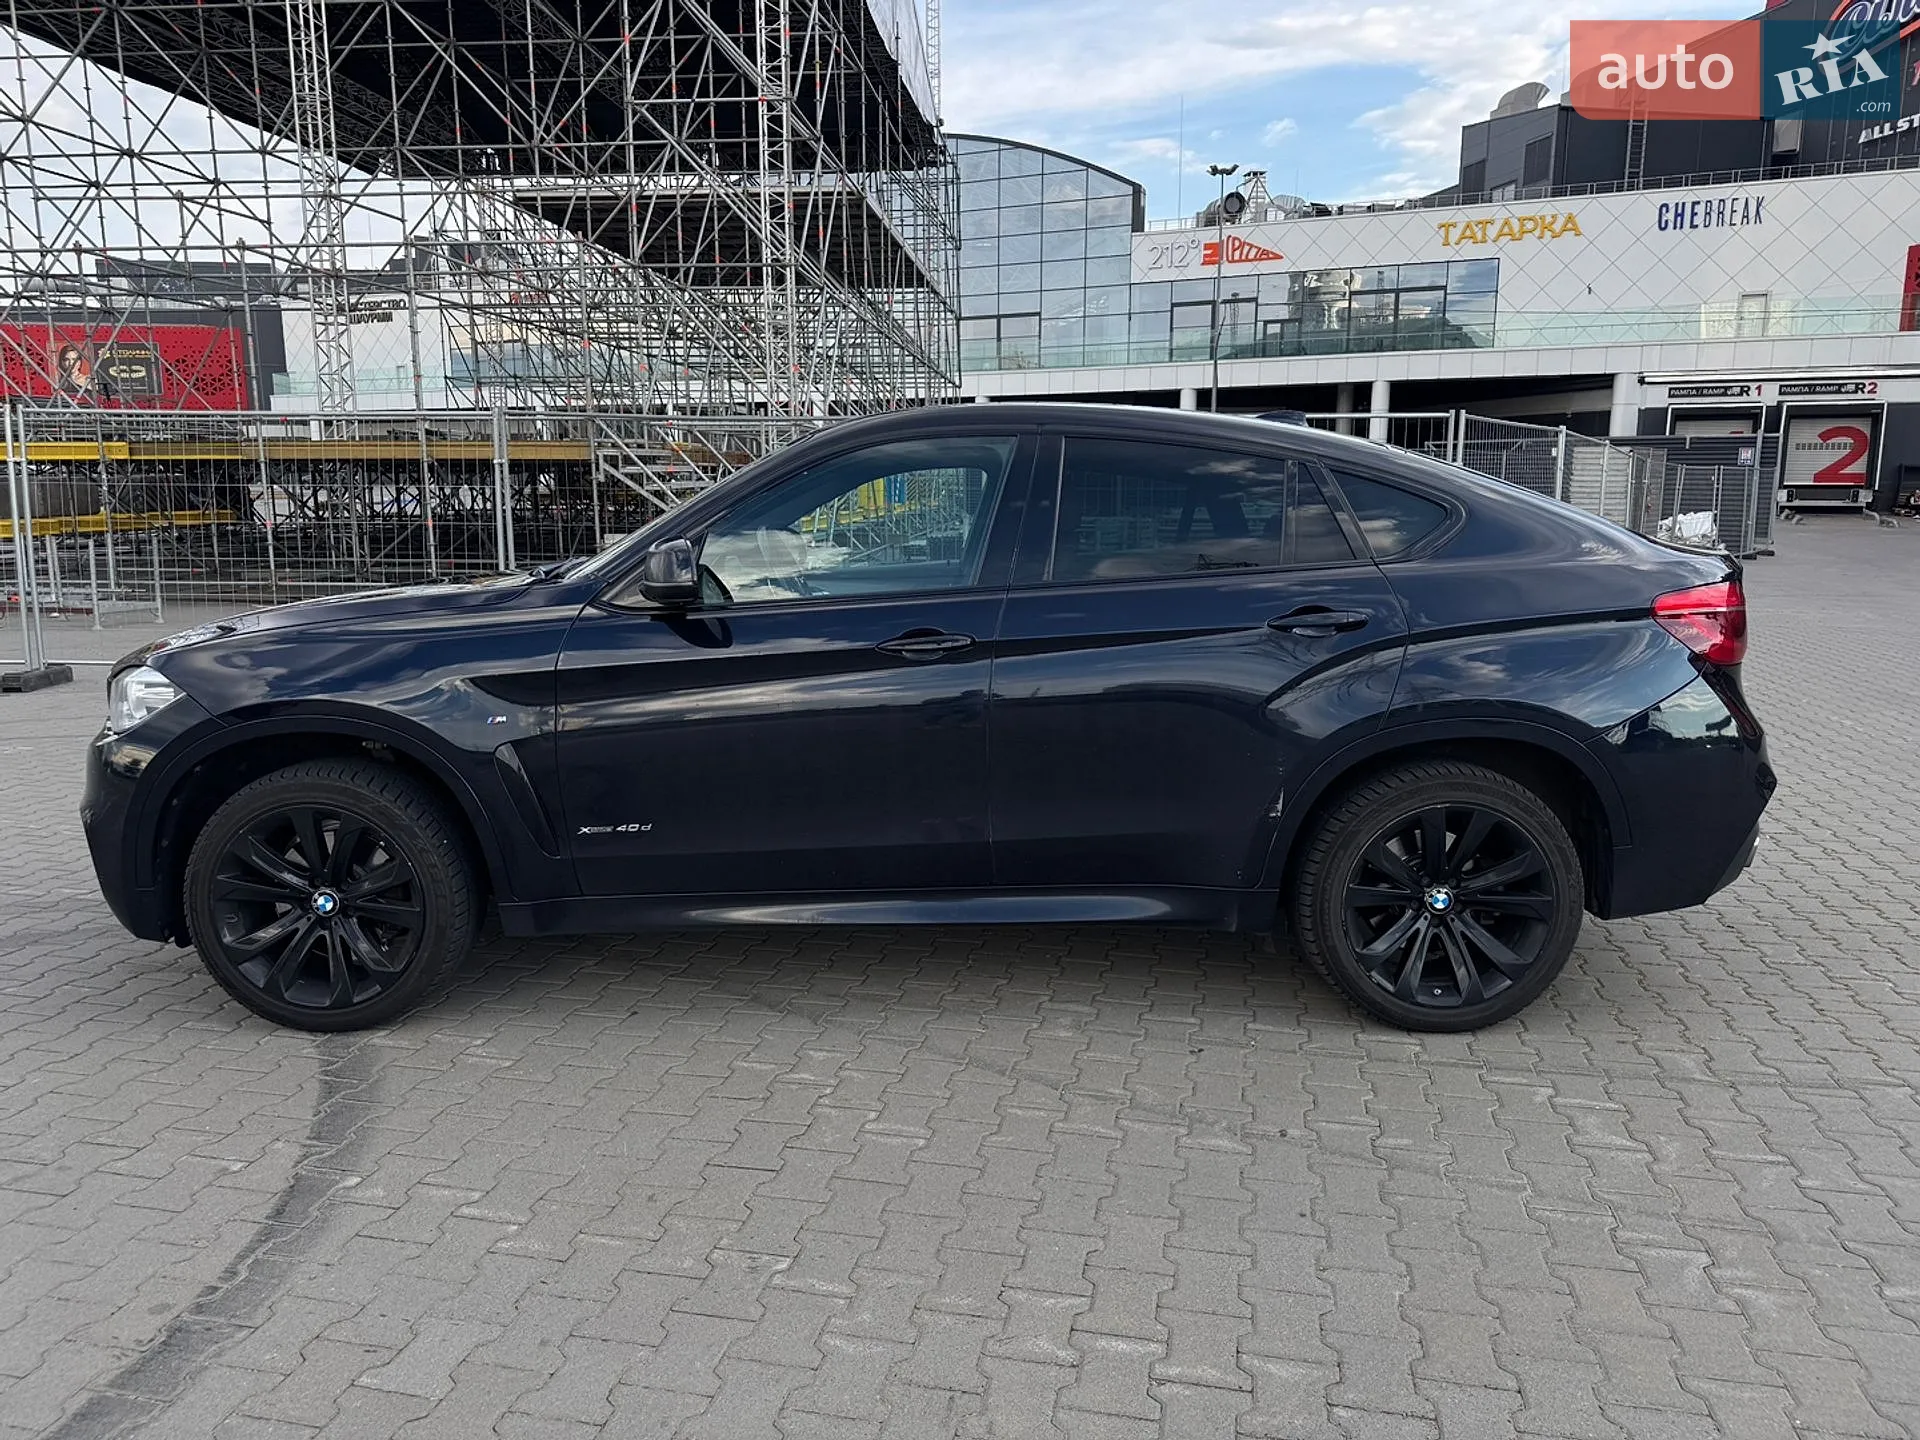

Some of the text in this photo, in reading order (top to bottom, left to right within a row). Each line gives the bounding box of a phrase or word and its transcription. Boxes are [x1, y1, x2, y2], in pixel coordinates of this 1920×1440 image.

[1437, 212, 1582, 246] ТАТАРКА
[1658, 196, 1765, 231] CHEBREAK
[1813, 425, 1869, 484] 2
